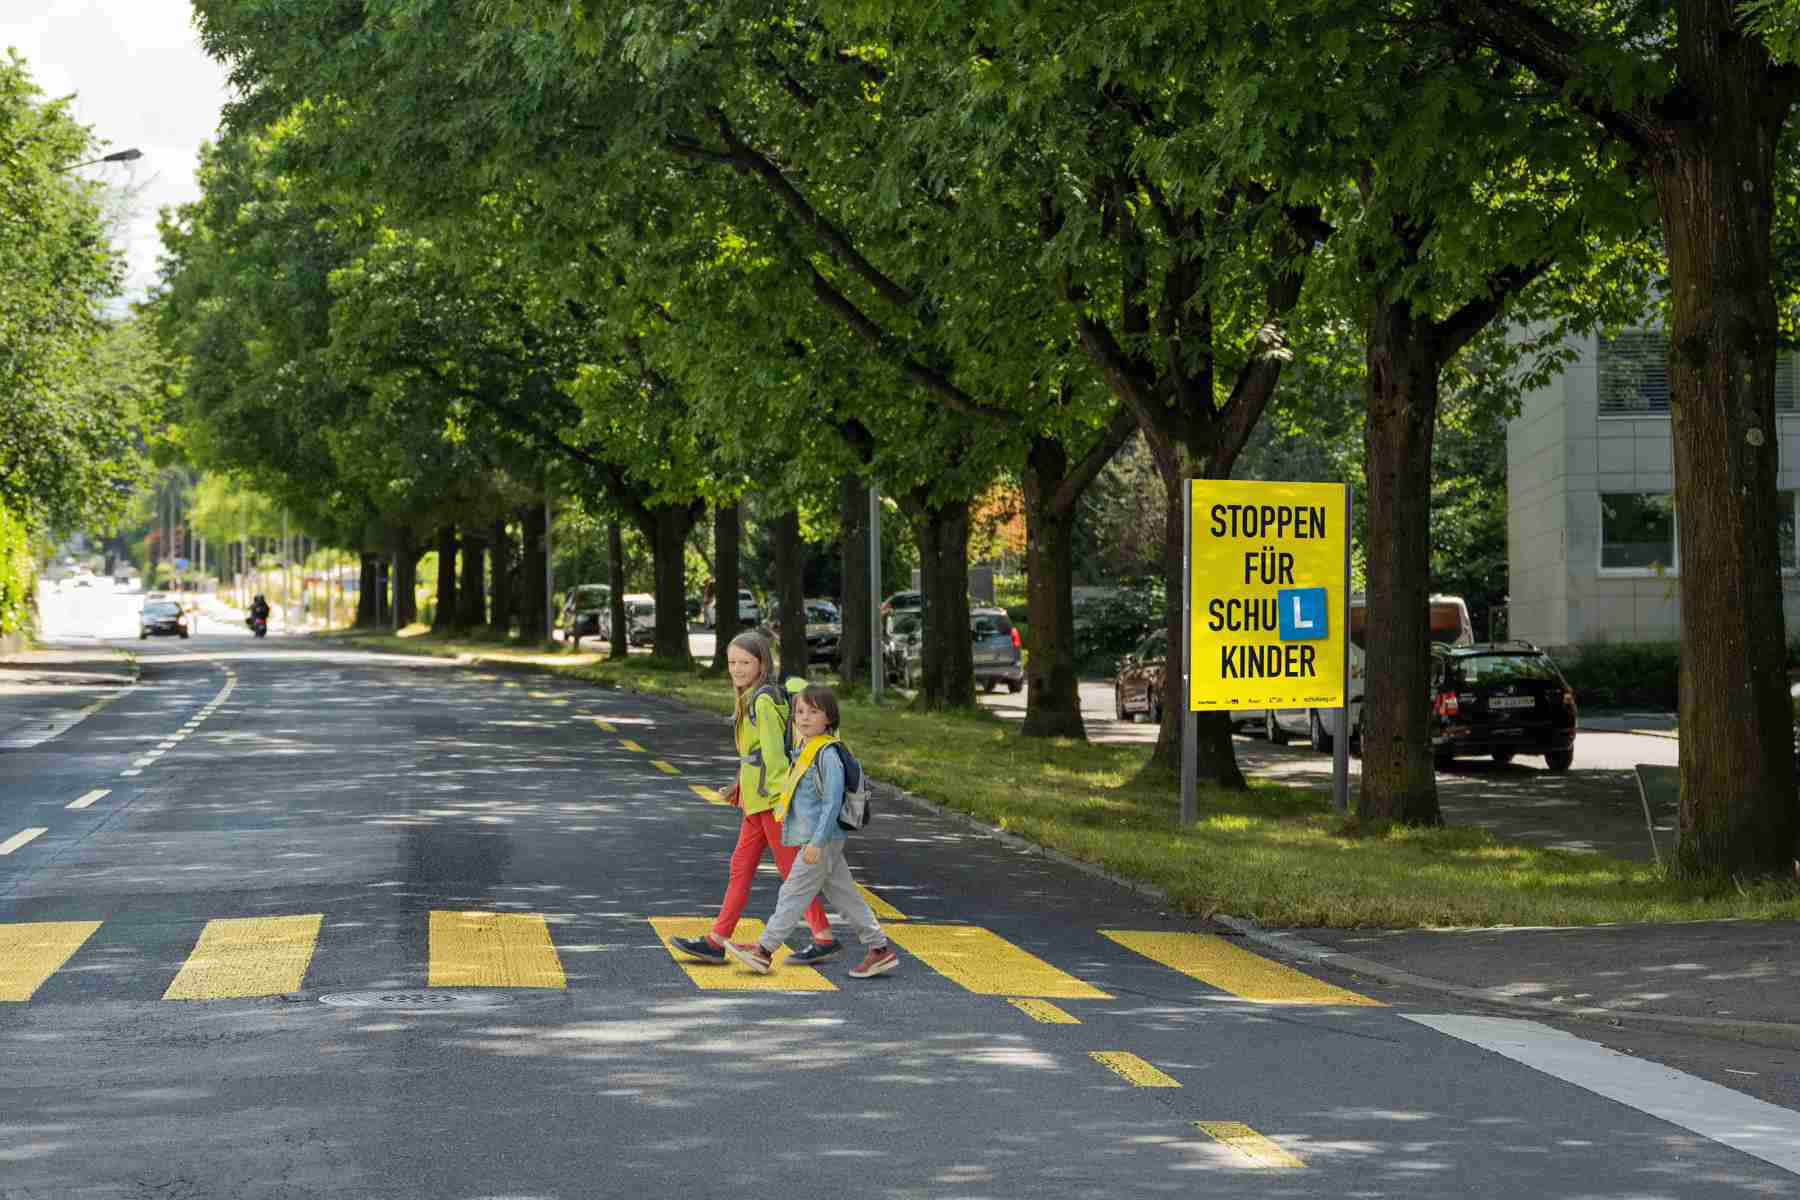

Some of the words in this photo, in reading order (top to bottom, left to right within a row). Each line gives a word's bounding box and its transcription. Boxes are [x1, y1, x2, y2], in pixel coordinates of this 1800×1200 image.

[1210, 504, 1326, 539] STOPPEN
[1245, 546, 1295, 585] FÜR
[1221, 645, 1316, 679] KINDER
